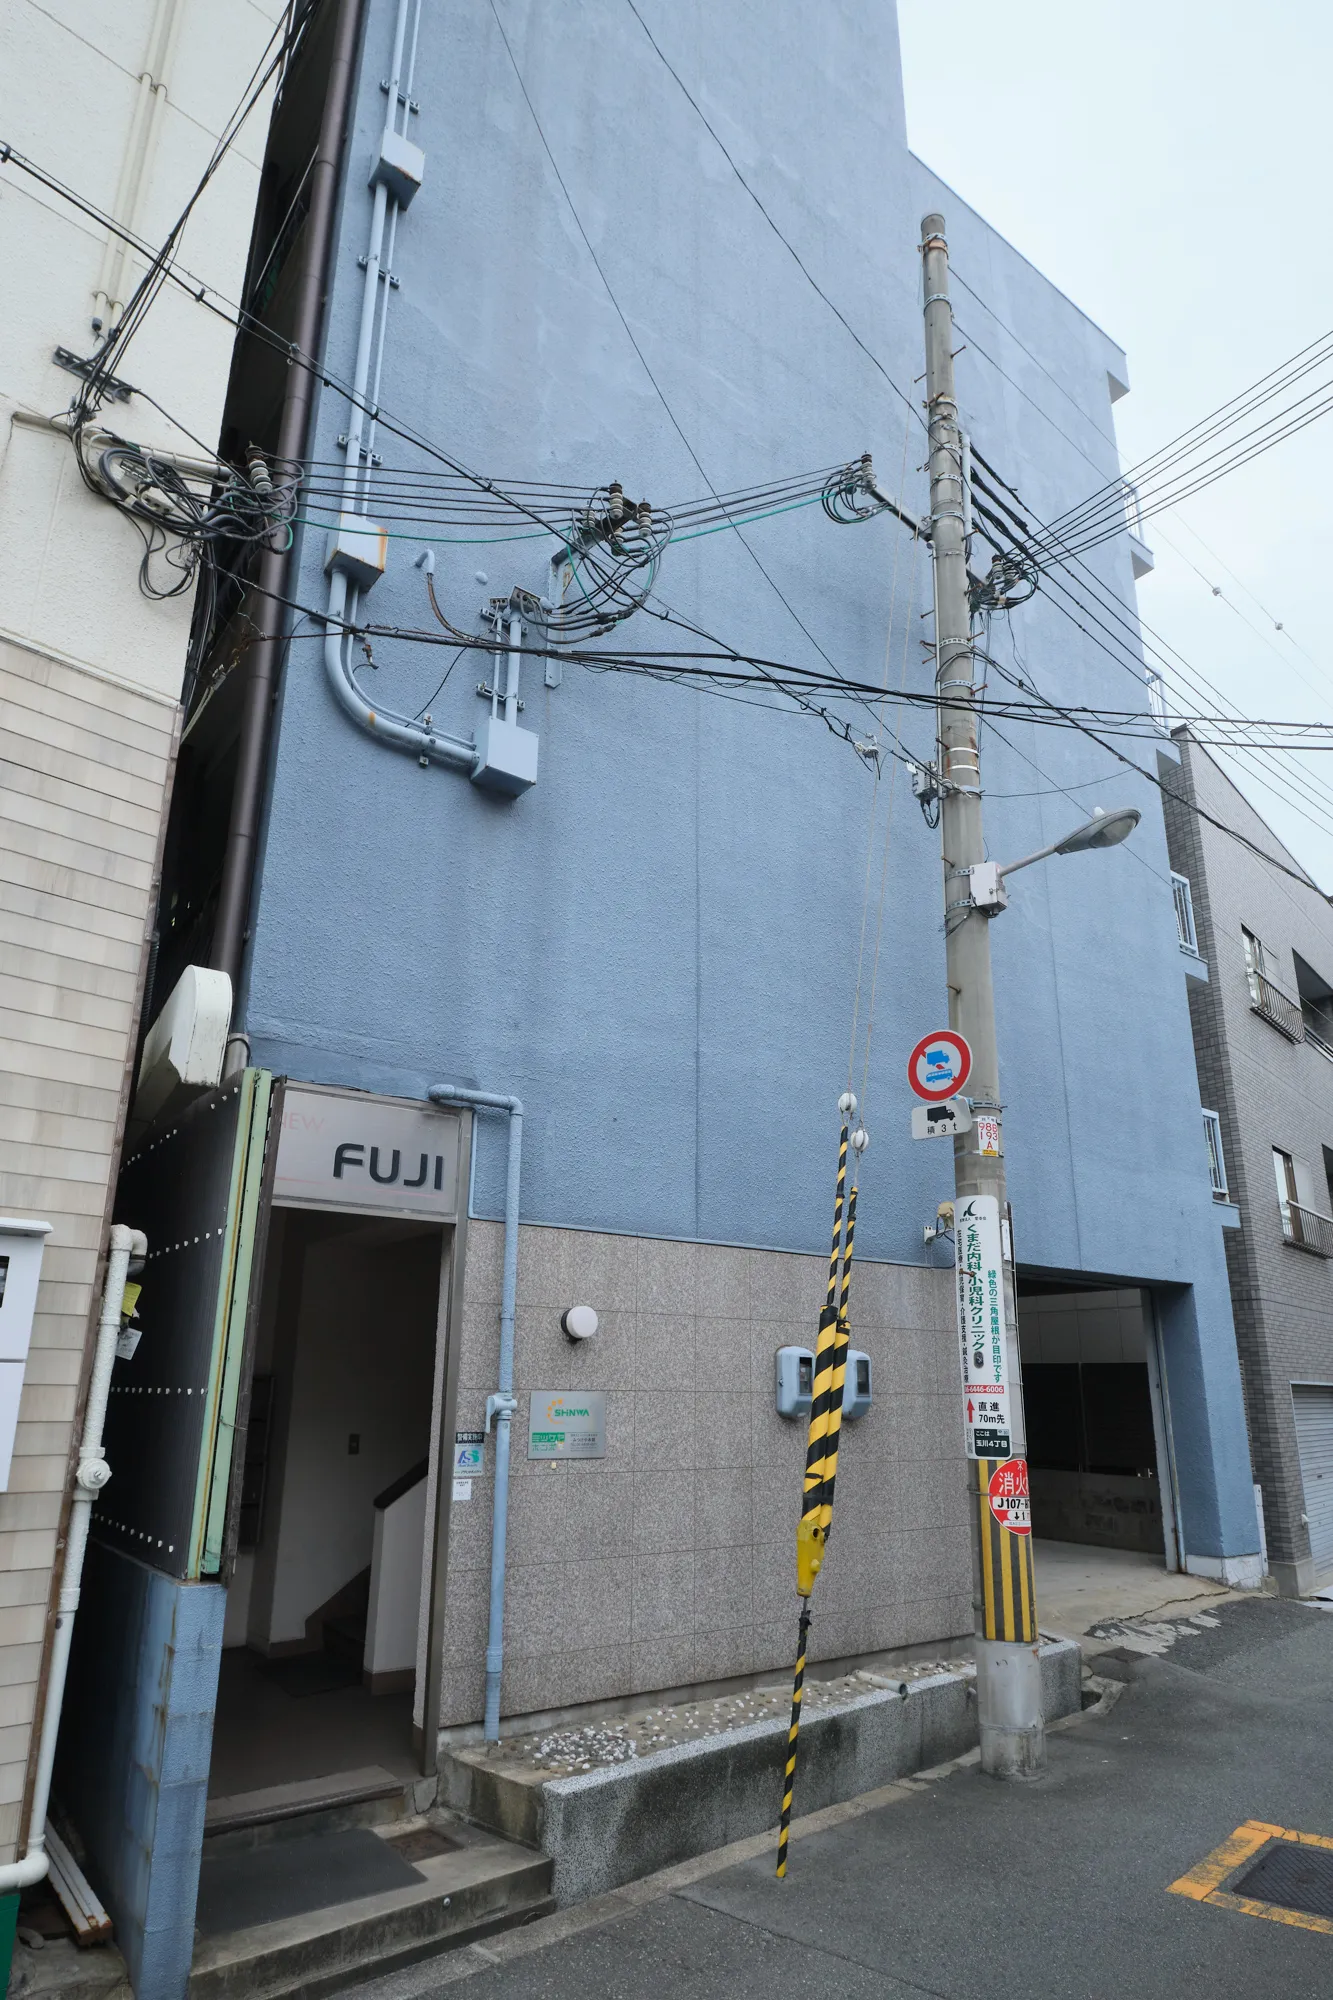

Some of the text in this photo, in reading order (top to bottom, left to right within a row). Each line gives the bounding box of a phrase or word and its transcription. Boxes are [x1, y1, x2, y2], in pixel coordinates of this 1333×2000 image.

[941, 1124, 947, 1133] 3
[953, 1122, 957, 1131] t
[986, 1141, 993, 1149] A
[333, 1142, 443, 1190] FUJI
[966, 1223, 986, 1351] くまだ内科小児科クリニック
[999, 1471, 1029, 1495] 消火
